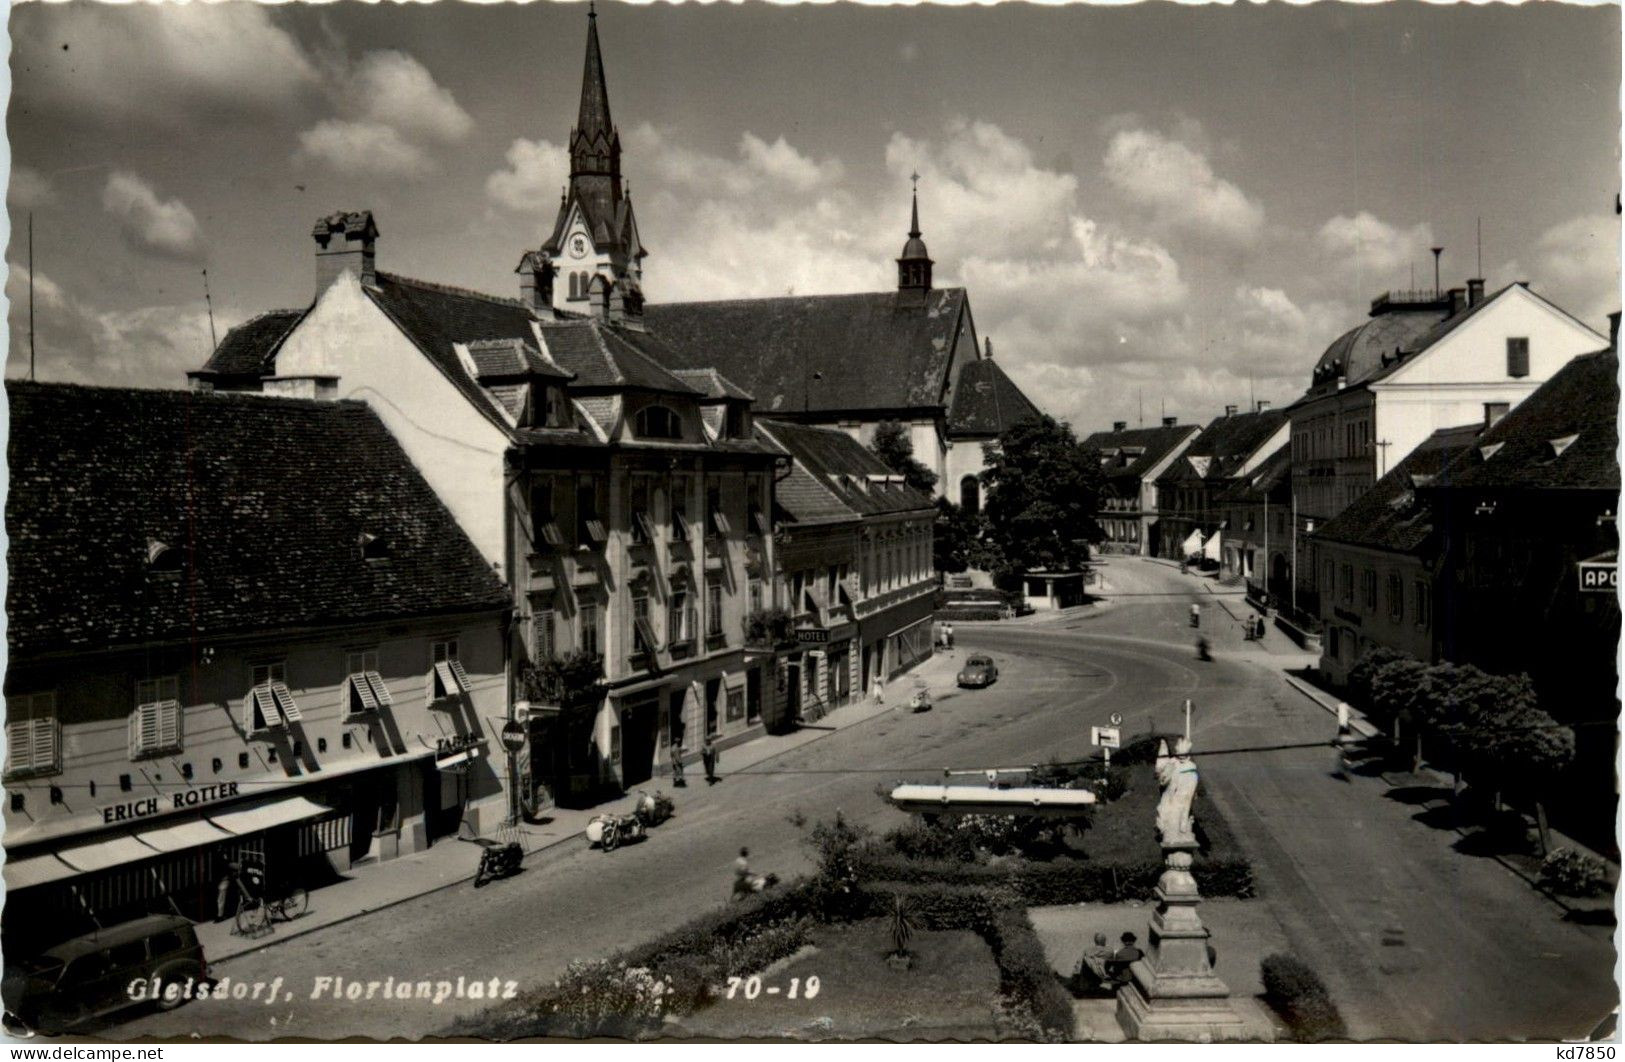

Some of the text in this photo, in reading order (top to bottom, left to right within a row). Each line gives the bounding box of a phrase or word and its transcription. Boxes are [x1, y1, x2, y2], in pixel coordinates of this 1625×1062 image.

[797, 631, 826, 641] HOTEL
[103, 782, 239, 824] ERICH ROTTER
